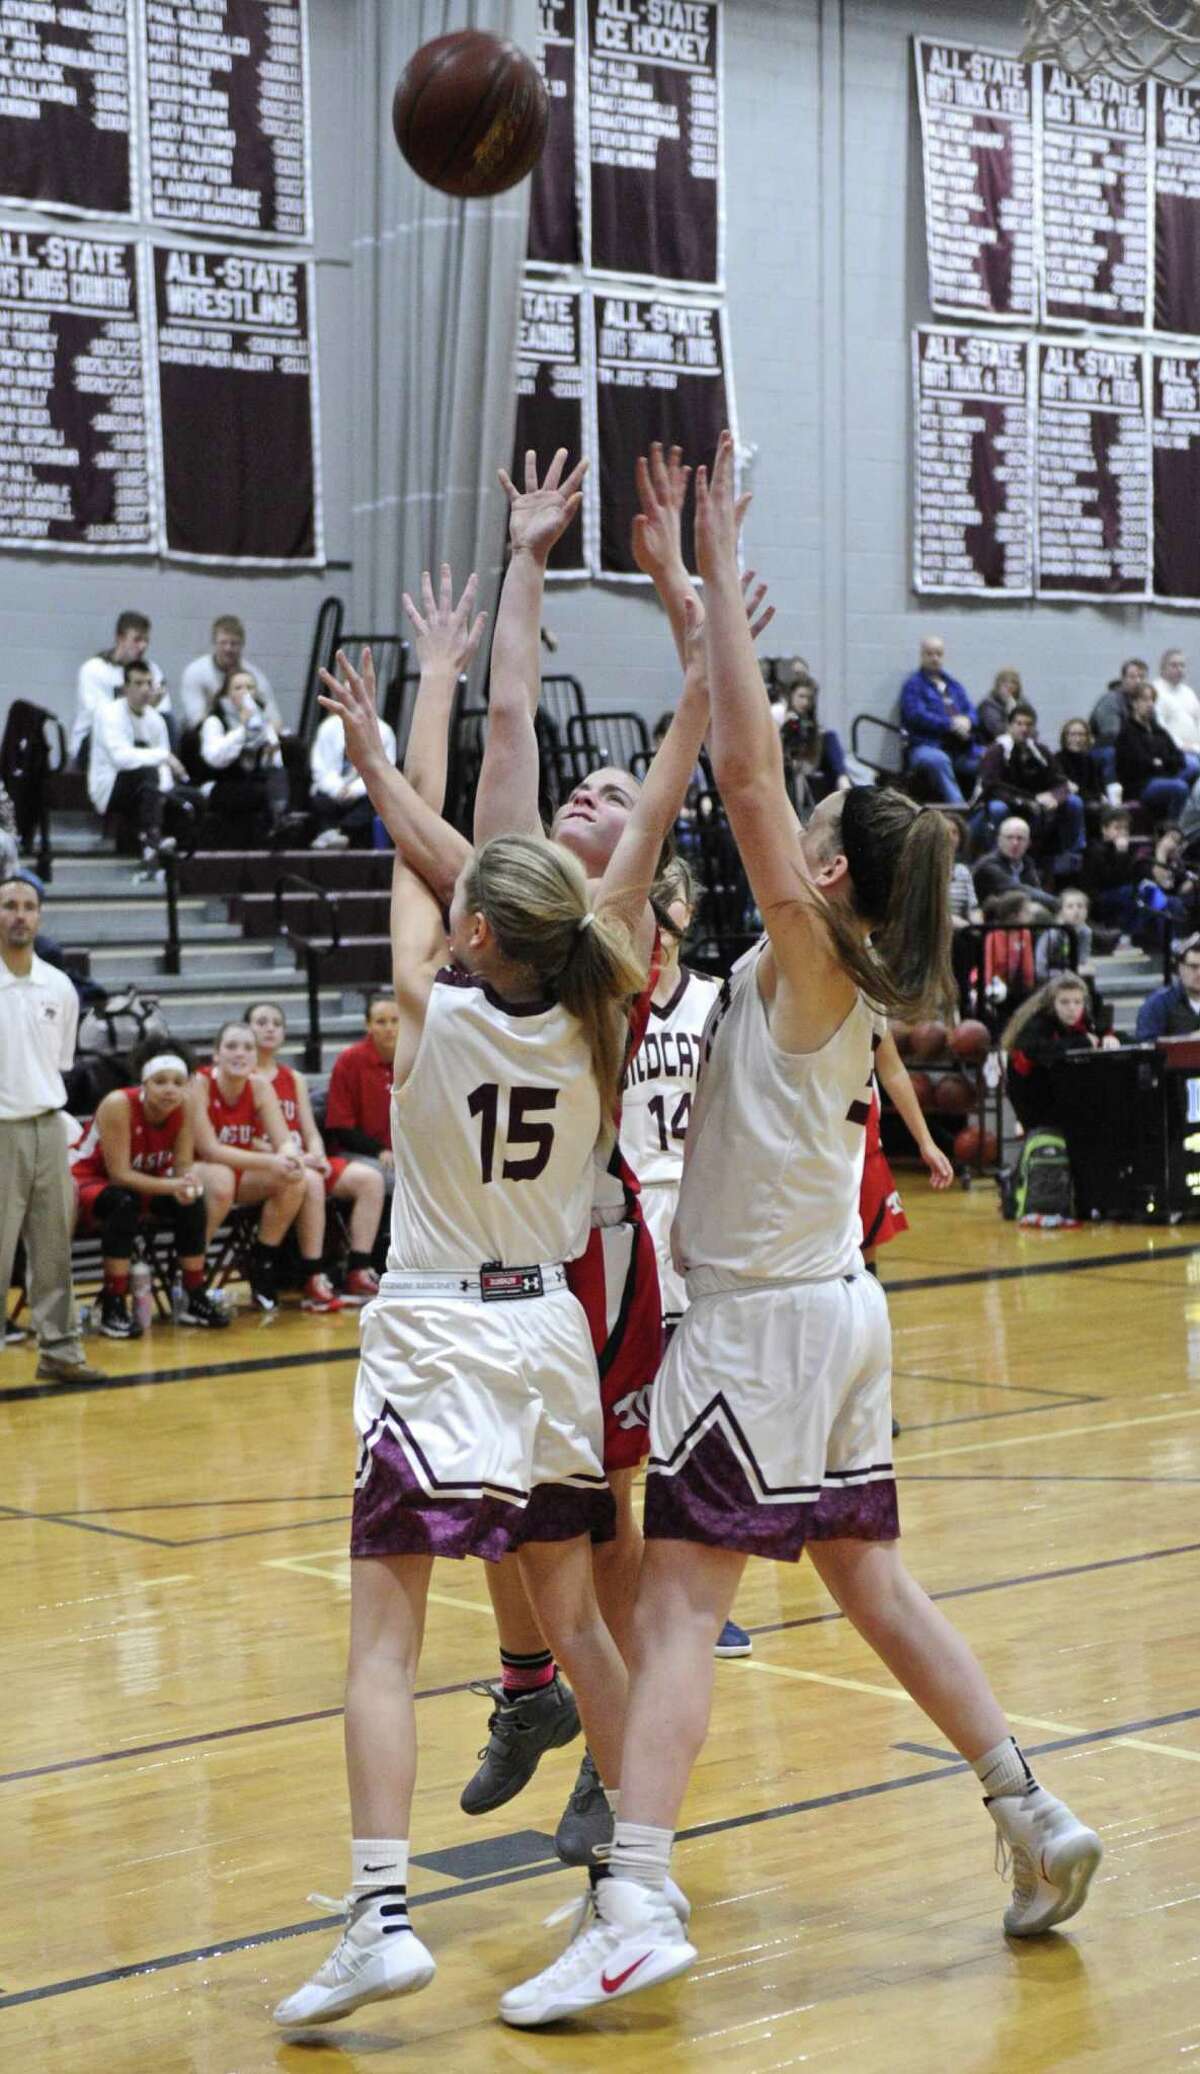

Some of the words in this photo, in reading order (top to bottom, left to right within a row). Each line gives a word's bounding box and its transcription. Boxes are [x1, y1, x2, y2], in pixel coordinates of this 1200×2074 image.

[594, 17, 629, 50] ICE
[631, 24, 710, 63] HOCKEY
[166, 283, 298, 326] WRESTLING
[466, 1082, 560, 1185] 15
[647, 1092, 693, 1151] 14
